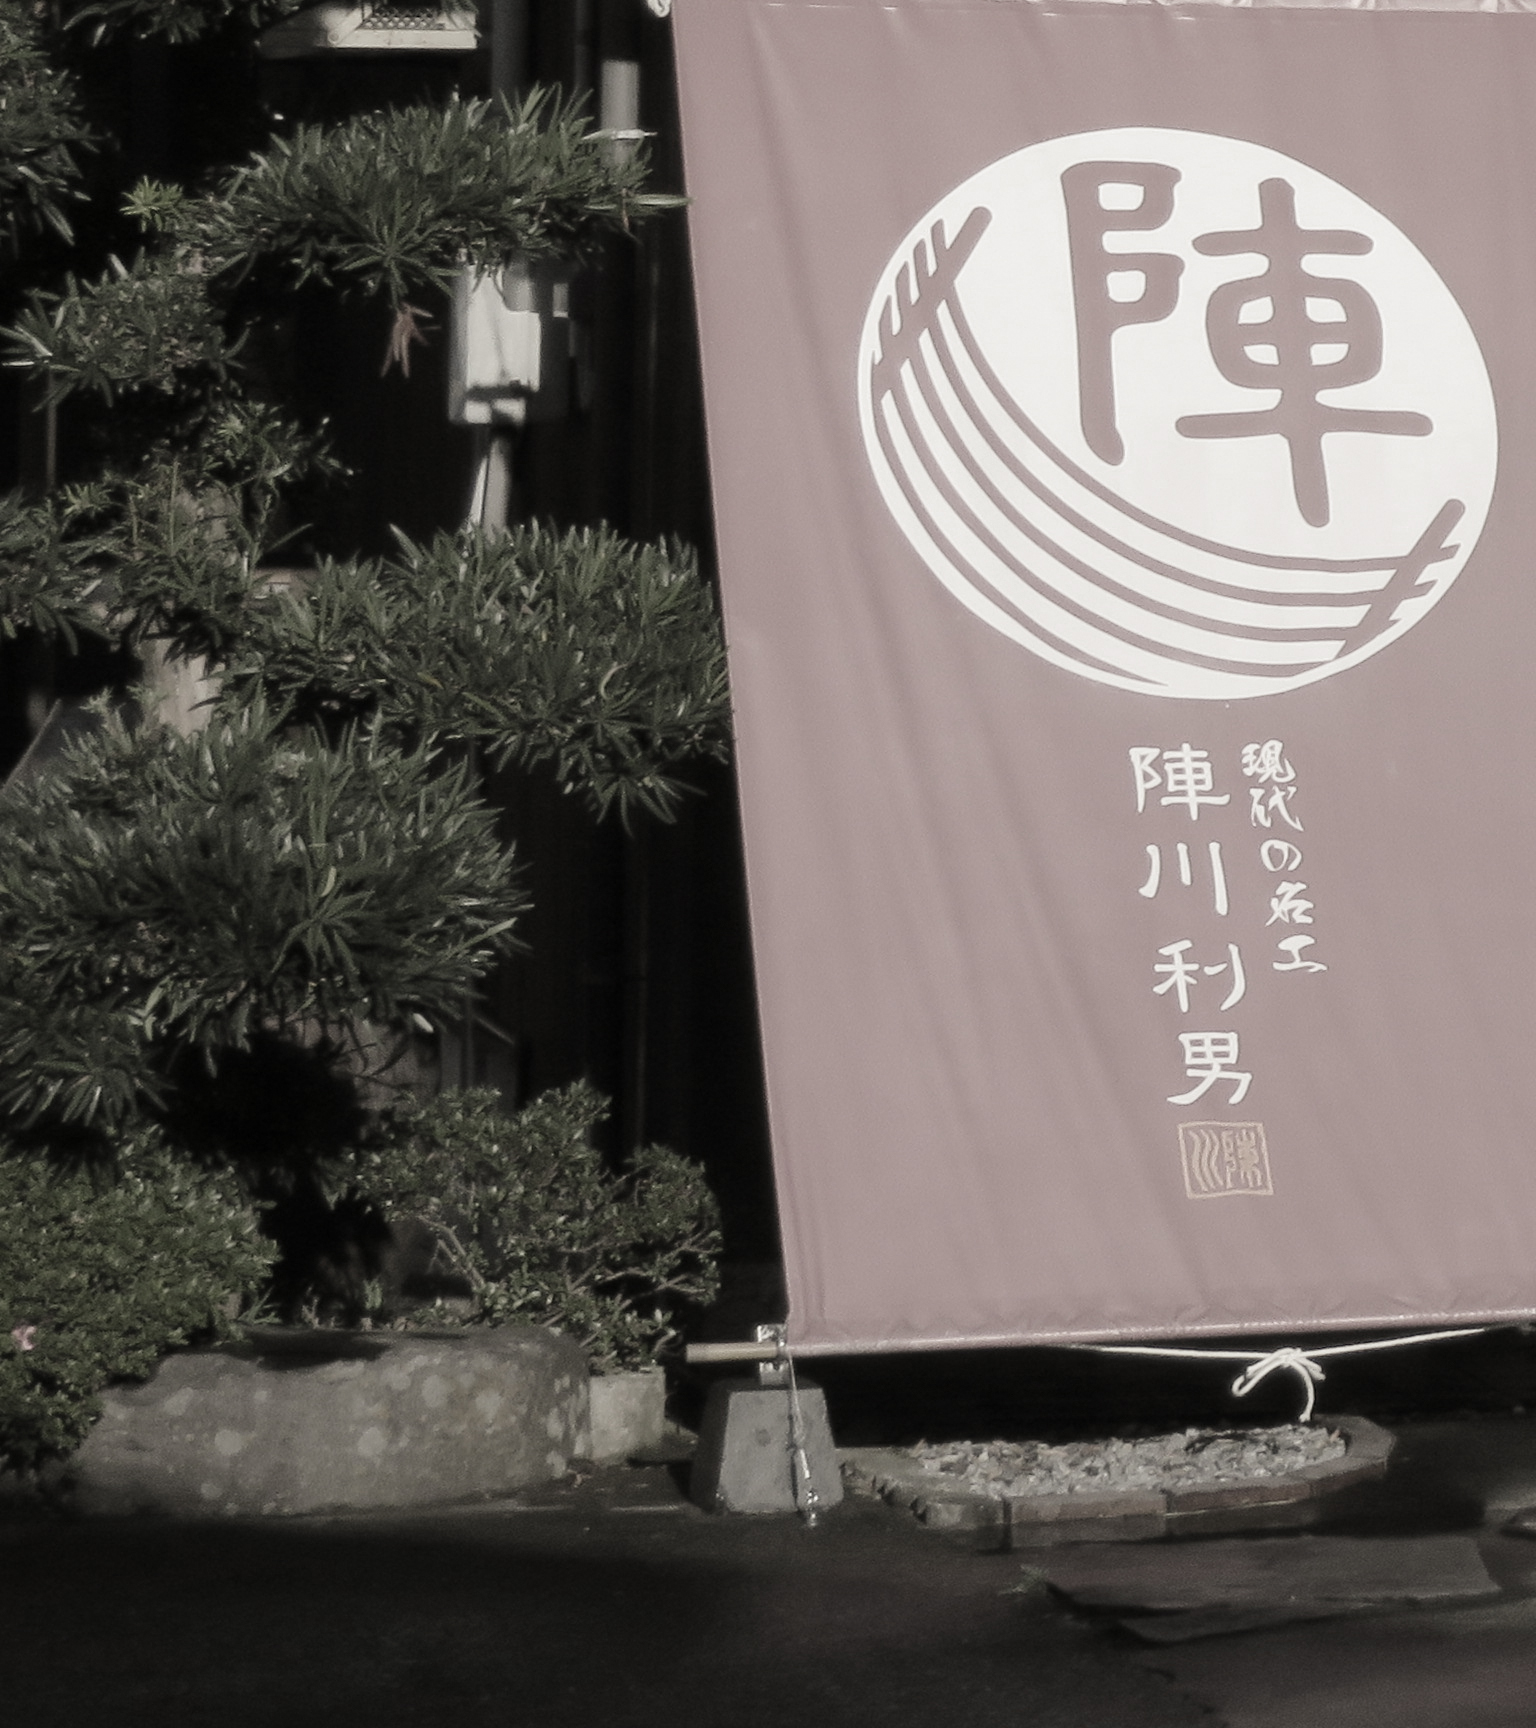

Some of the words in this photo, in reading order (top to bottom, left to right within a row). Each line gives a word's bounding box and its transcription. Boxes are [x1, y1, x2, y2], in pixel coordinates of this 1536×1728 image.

[1060, 159, 1434, 528] 陣
[1128, 742, 1253, 1105] 陣川利男
